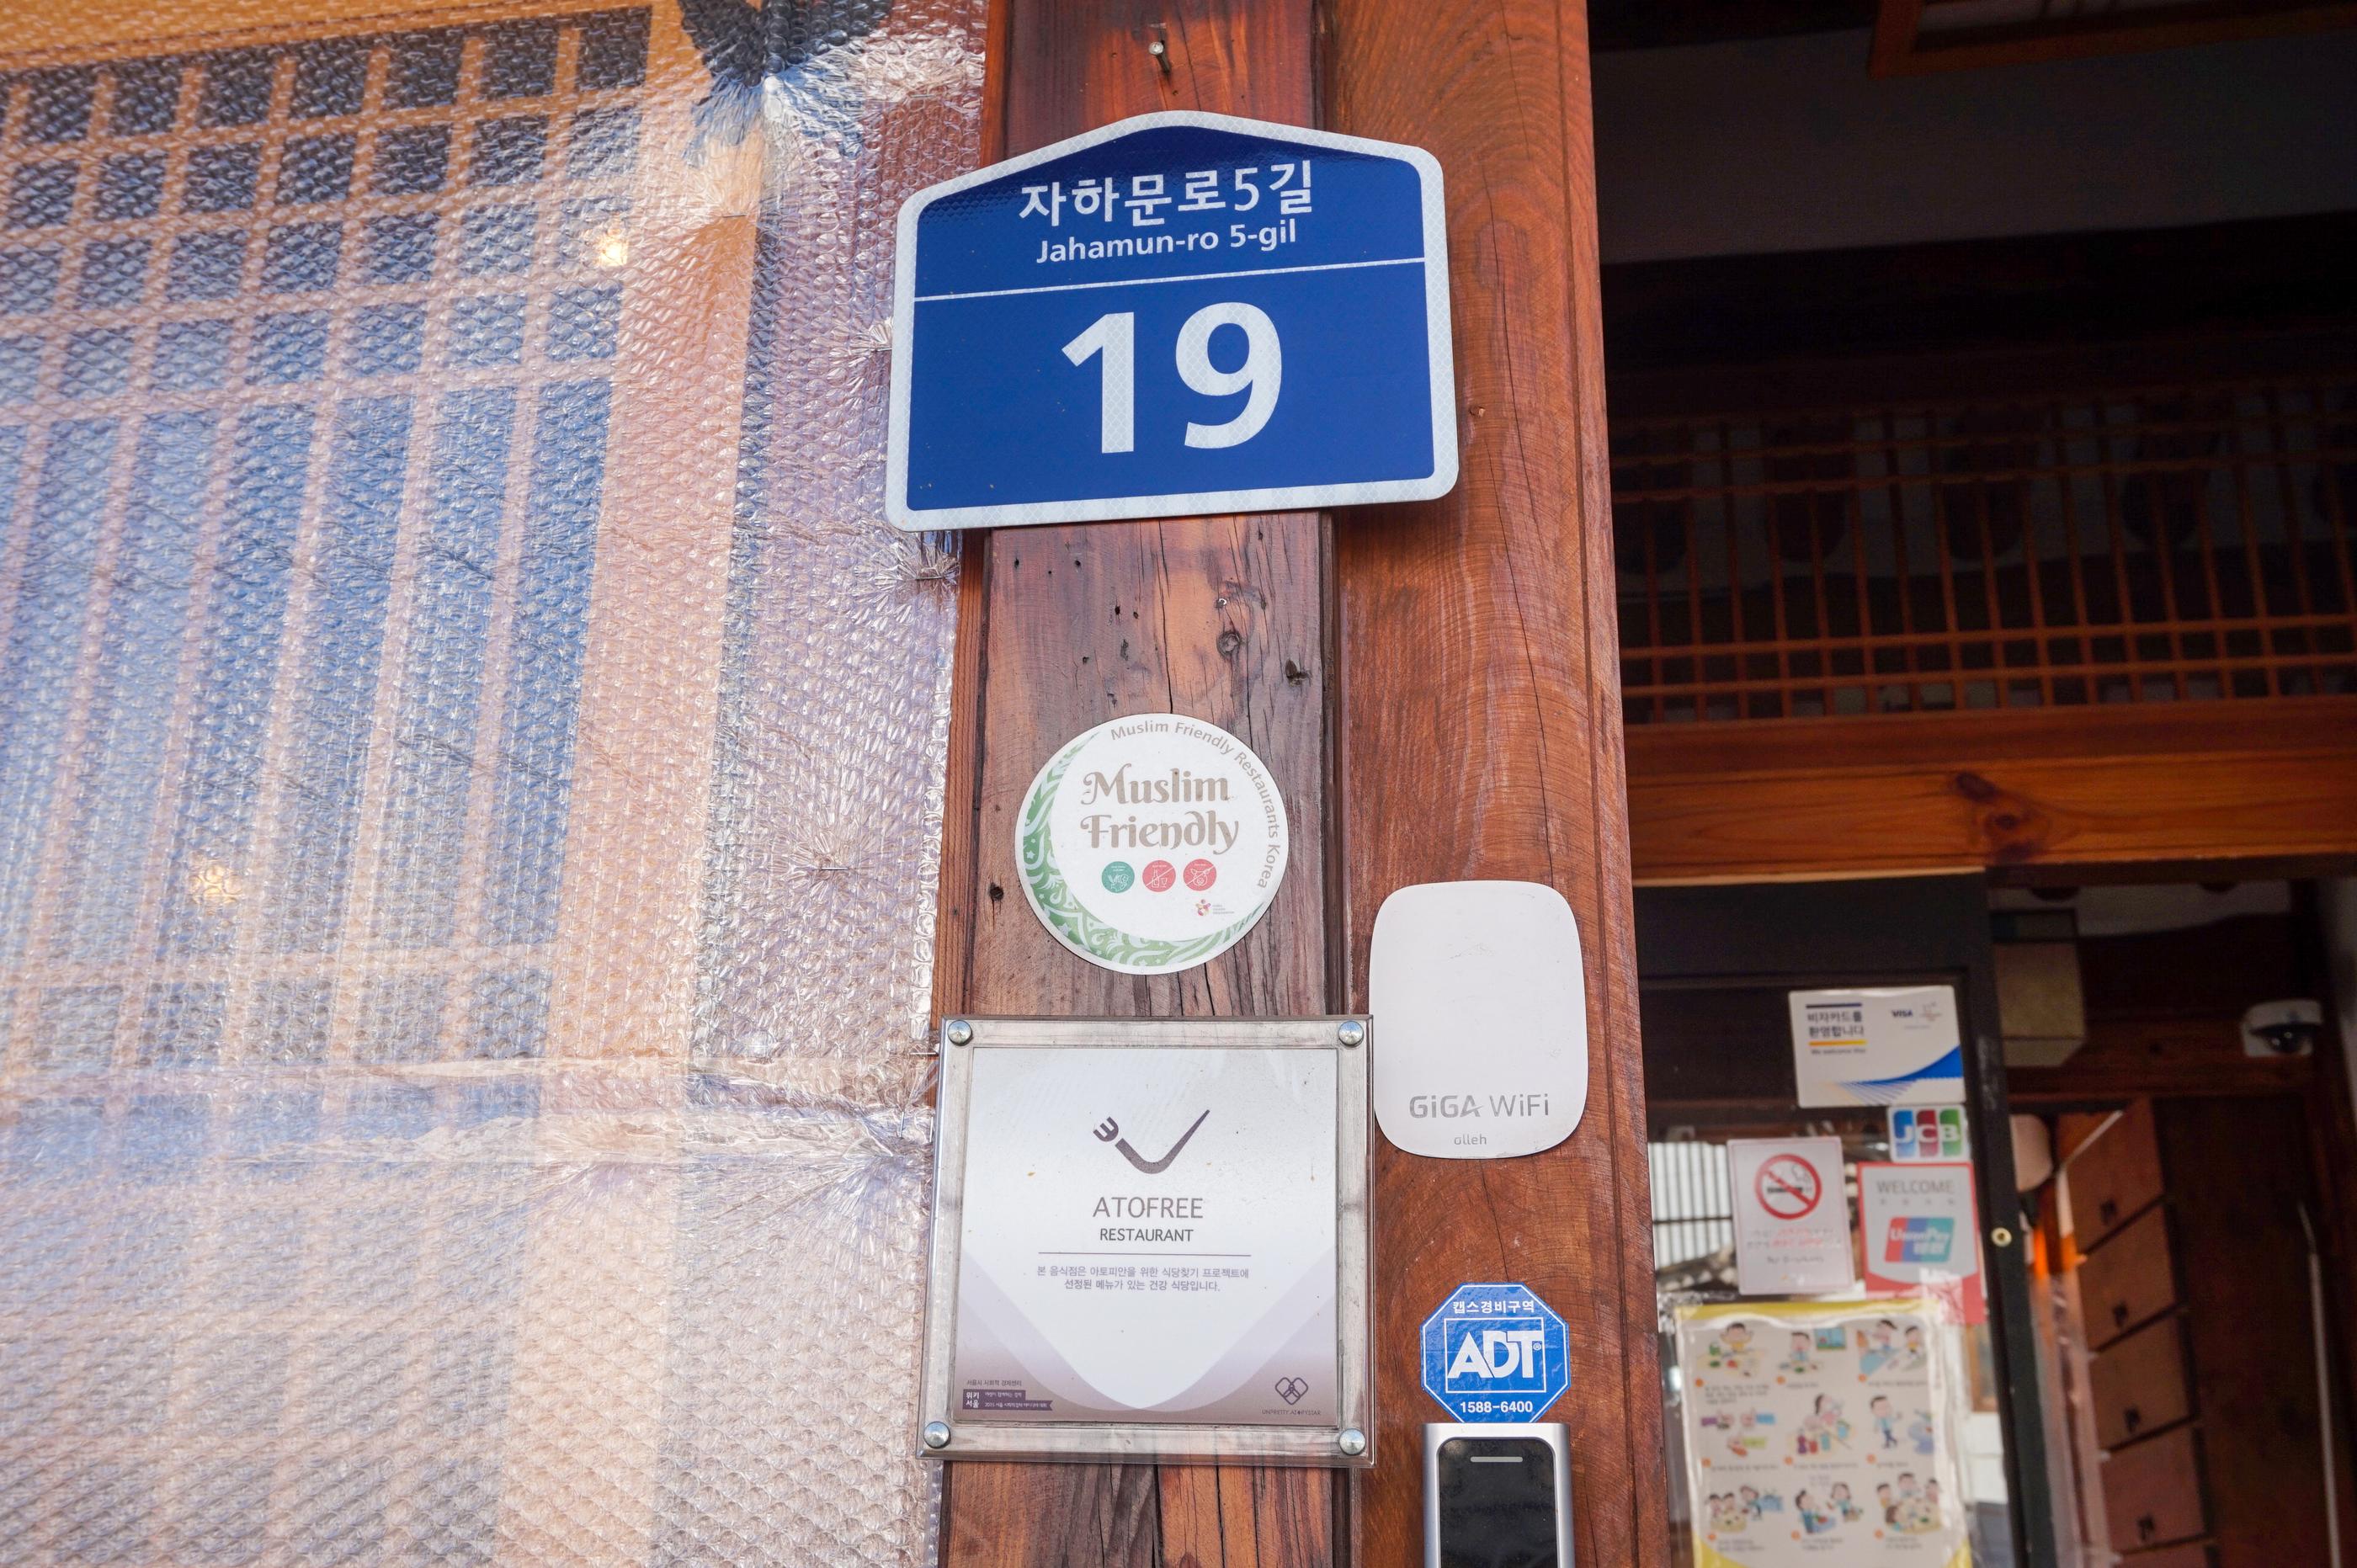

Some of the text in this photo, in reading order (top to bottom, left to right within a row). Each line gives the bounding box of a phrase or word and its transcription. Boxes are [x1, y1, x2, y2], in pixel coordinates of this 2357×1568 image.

[1018, 159, 1313, 227] 자하문로5길
[1035, 218, 1297, 263] Jahamun-ro 5-gil
[1061, 300, 1283, 454] 19
[1081, 763, 1230, 805] Muslim
[1109, 720, 1281, 889] Muslim Friendly Restaurants Korea
[1080, 810, 1240, 856] Friendly
[1806, 1011, 1862, 1023] 비자카드를
[1808, 1025, 1865, 1038] 환영합니다
[1489, 1093, 1549, 1118] WiFi
[1454, 1134, 1487, 1145] olleh
[1876, 1179, 1955, 1193] WELCOME
[1092, 1196, 1204, 1219] ATOFREE
[1099, 1228, 1194, 1242] RESTAURANT
[1036, 1265, 1249, 1279] 본 음식점은 아토피안을 위한 식당찾기 프로젝트에
[1064, 1279, 1221, 1292] 선정된 메뉴가 있는 건강 식당입니다.
[1452, 1300, 1535, 1315] 캡스경비구역
[1447, 1330, 1544, 1379] ADT
[966, 1391, 980, 1400] 위키
[966, 1399, 980, 1409] 서울
[1460, 1401, 1534, 1414] 1588-6400
